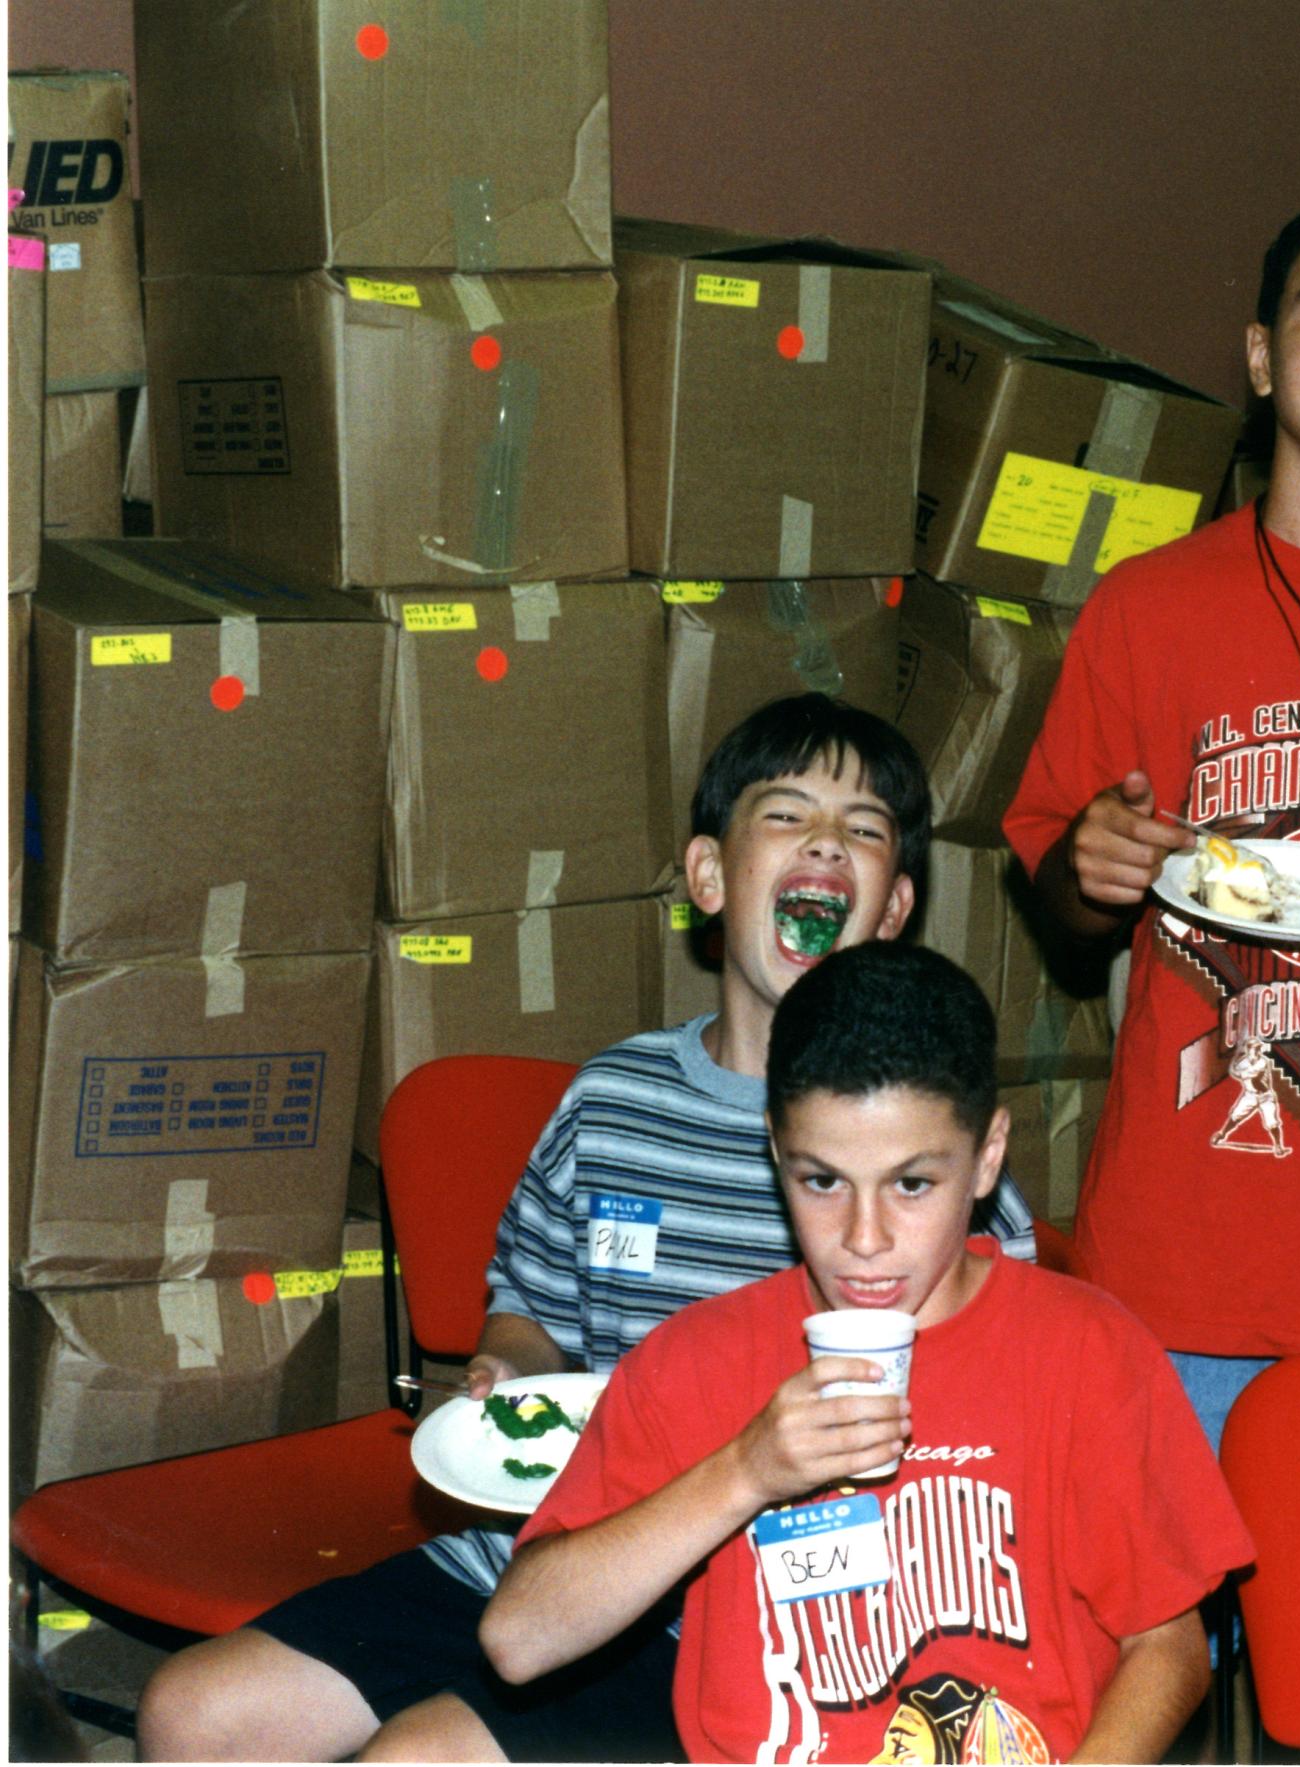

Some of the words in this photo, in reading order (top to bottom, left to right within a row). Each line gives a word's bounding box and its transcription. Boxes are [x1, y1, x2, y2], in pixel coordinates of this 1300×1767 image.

[9, 139, 123, 207] IED
[12, 209, 45, 228] Van
[1198, 714, 1245, 754] N.L.
[903, 1443, 996, 1467] icago
[780, 1503, 851, 1529] HELLO
[781, 1544, 850, 1585] BEN
